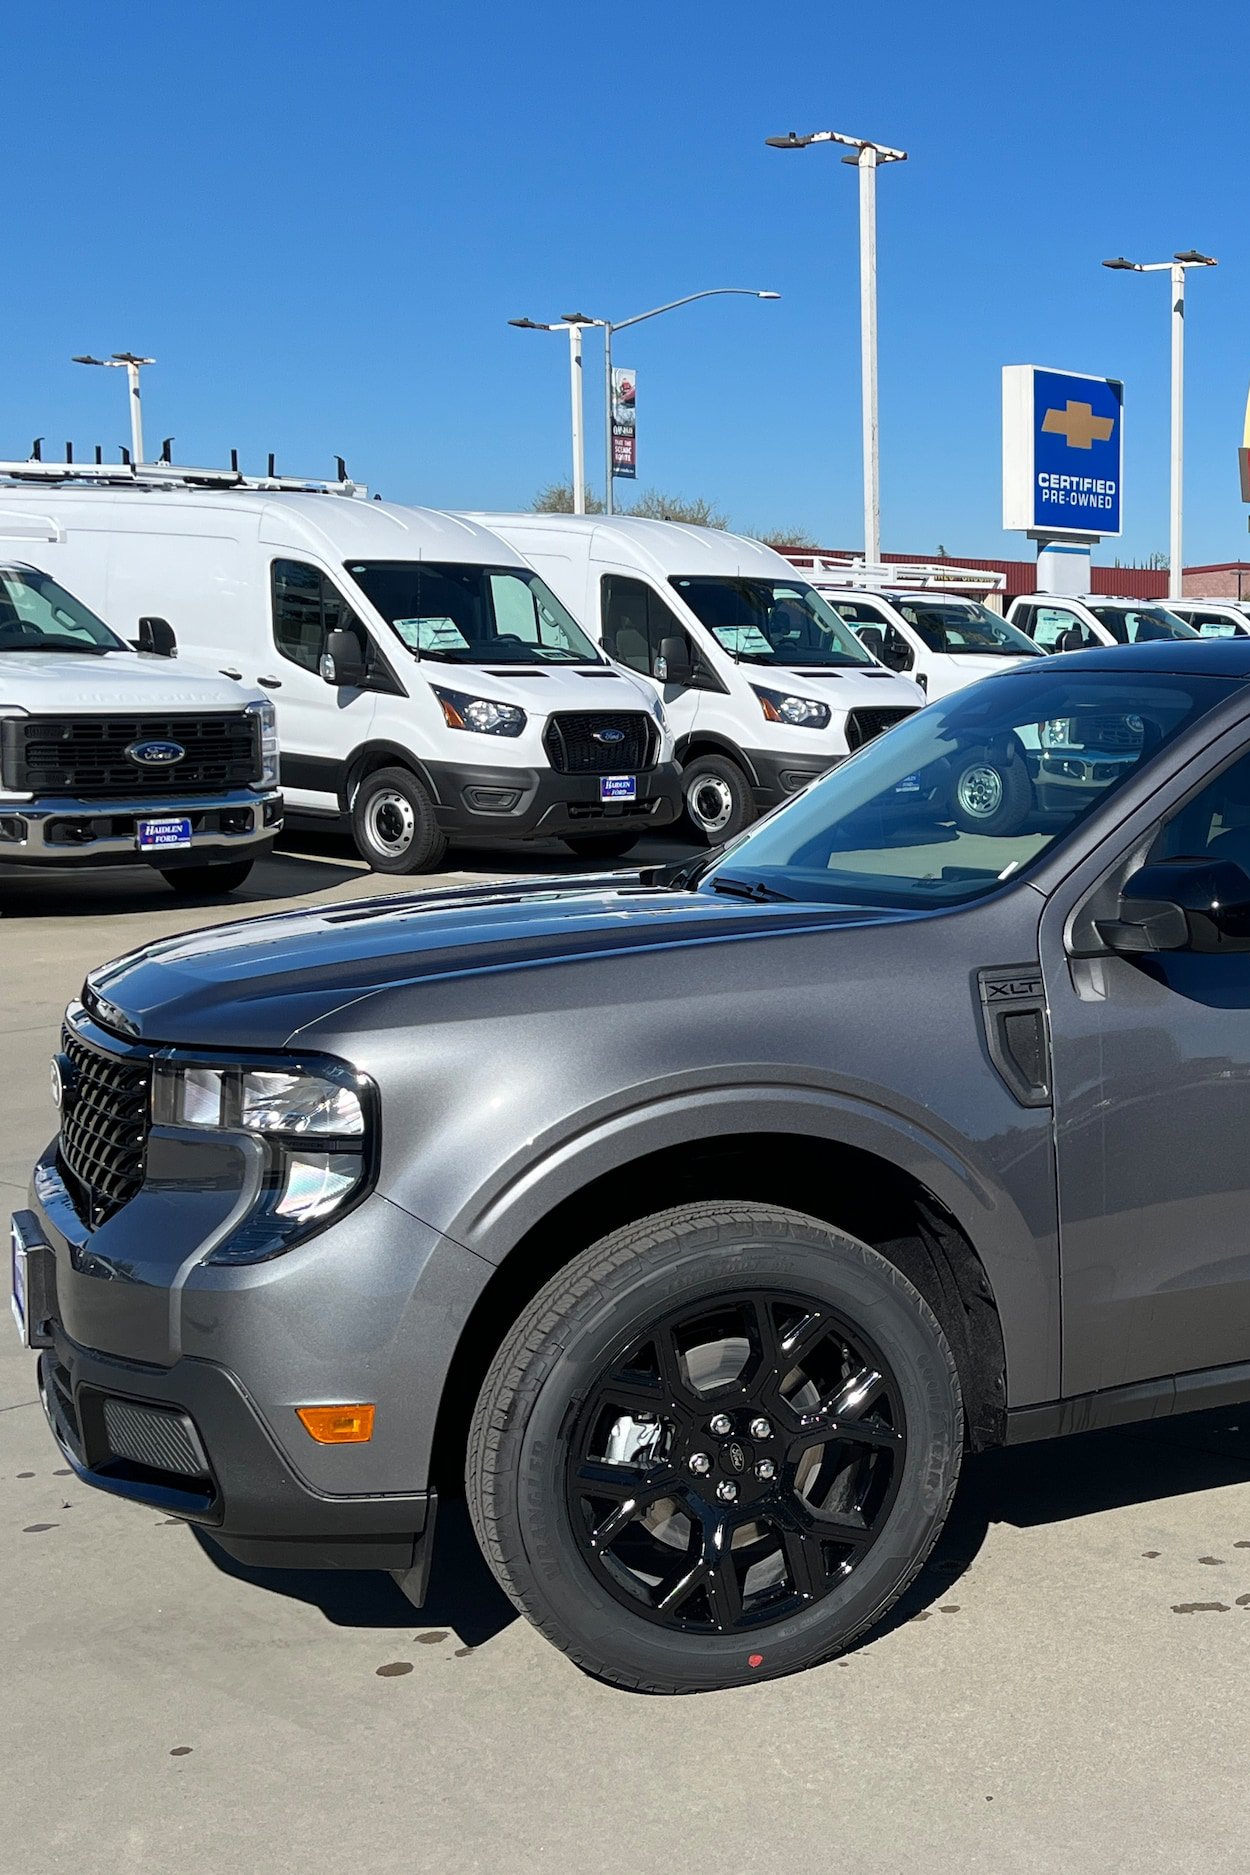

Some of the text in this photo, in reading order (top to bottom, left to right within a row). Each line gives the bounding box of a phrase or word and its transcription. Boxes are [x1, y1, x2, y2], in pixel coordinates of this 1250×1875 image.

[1038, 473, 1116, 494] CERTIFIED
[1042, 489, 1112, 509] PRE-OWNED
[145, 825, 183, 836] HAIDLEN
[155, 835, 178, 843] FORD
[988, 981, 1041, 997] XLT
